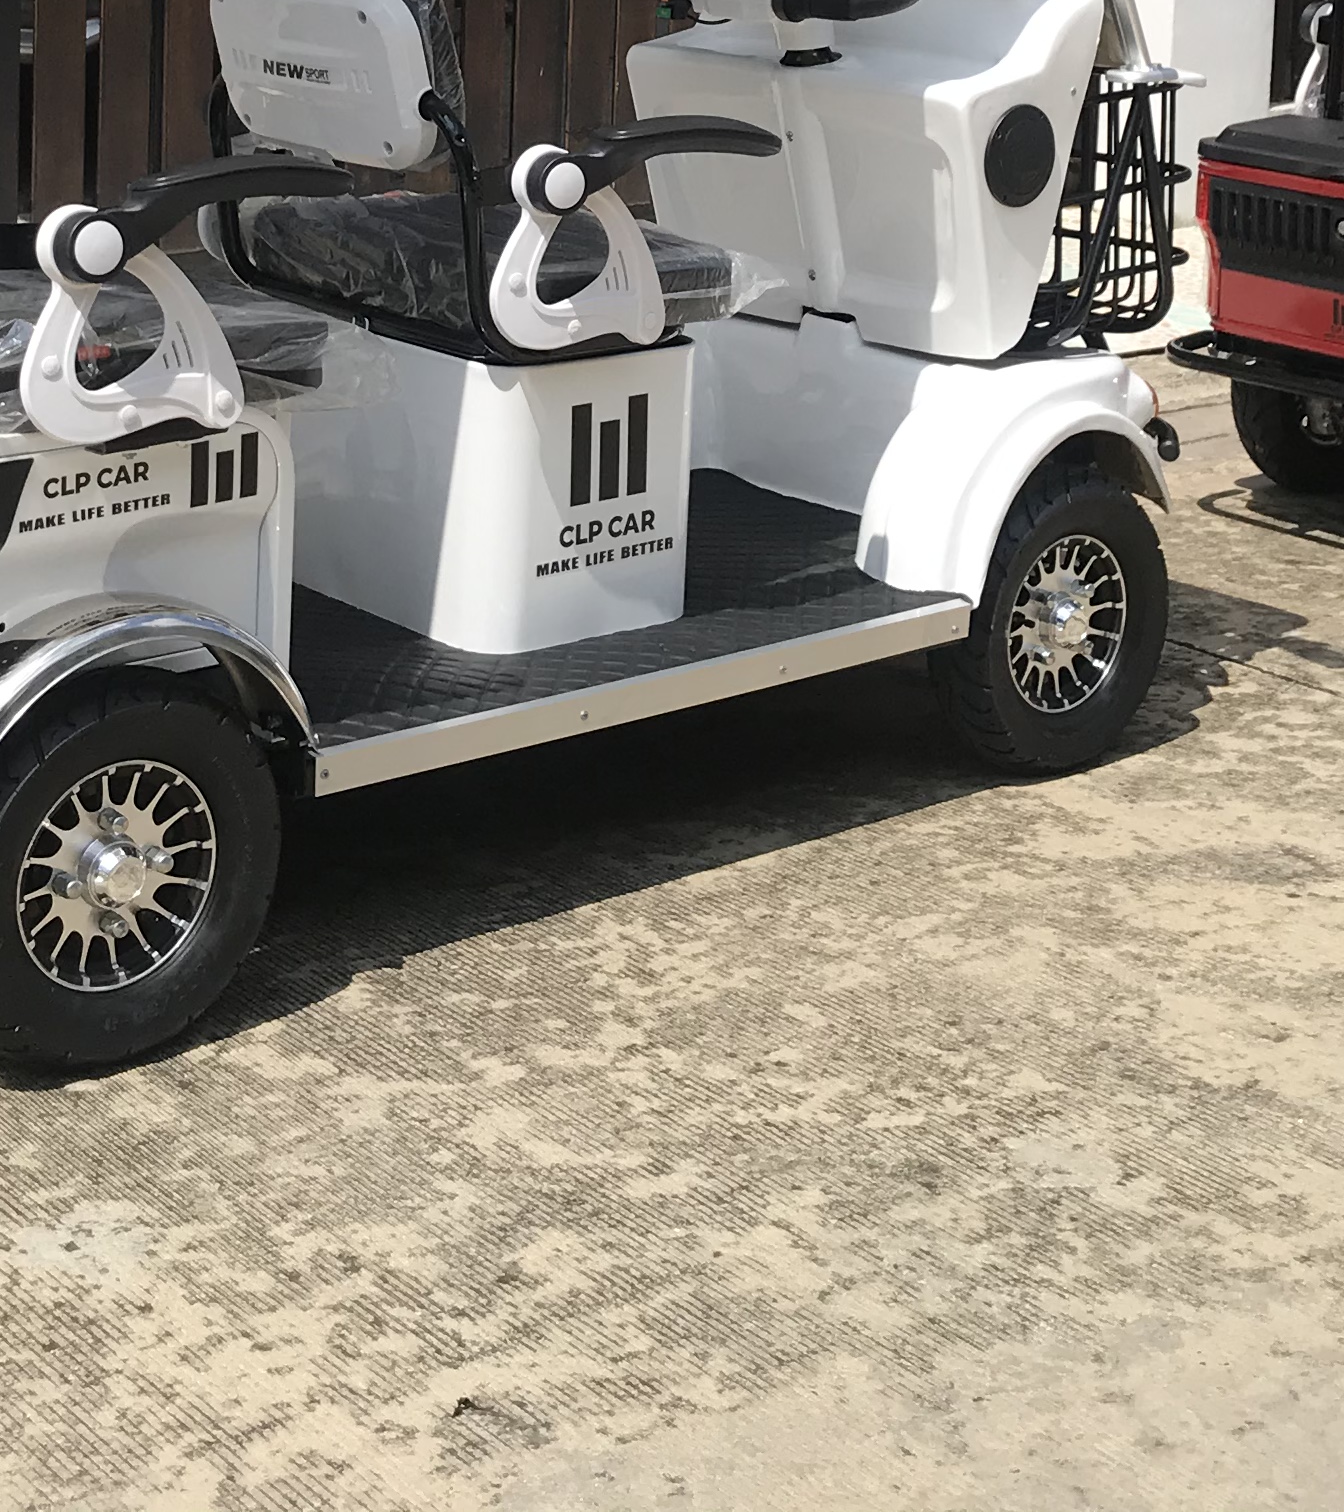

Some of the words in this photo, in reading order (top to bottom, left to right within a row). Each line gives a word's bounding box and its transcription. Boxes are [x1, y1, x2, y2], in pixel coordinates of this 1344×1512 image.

[262, 58, 304, 80] NEW
[43, 472, 91, 499] CLP
[97, 461, 150, 489] CAR
[19, 513, 66, 533] MAKE
[72, 505, 105, 523] LIFE
[112, 493, 171, 515] BETTER
[559, 520, 603, 548] CLP
[608, 509, 656, 538] CAR
[536, 556, 580, 577] MAKE
[586, 549, 615, 567] LIFE
[621, 536, 674, 559] BETTER
